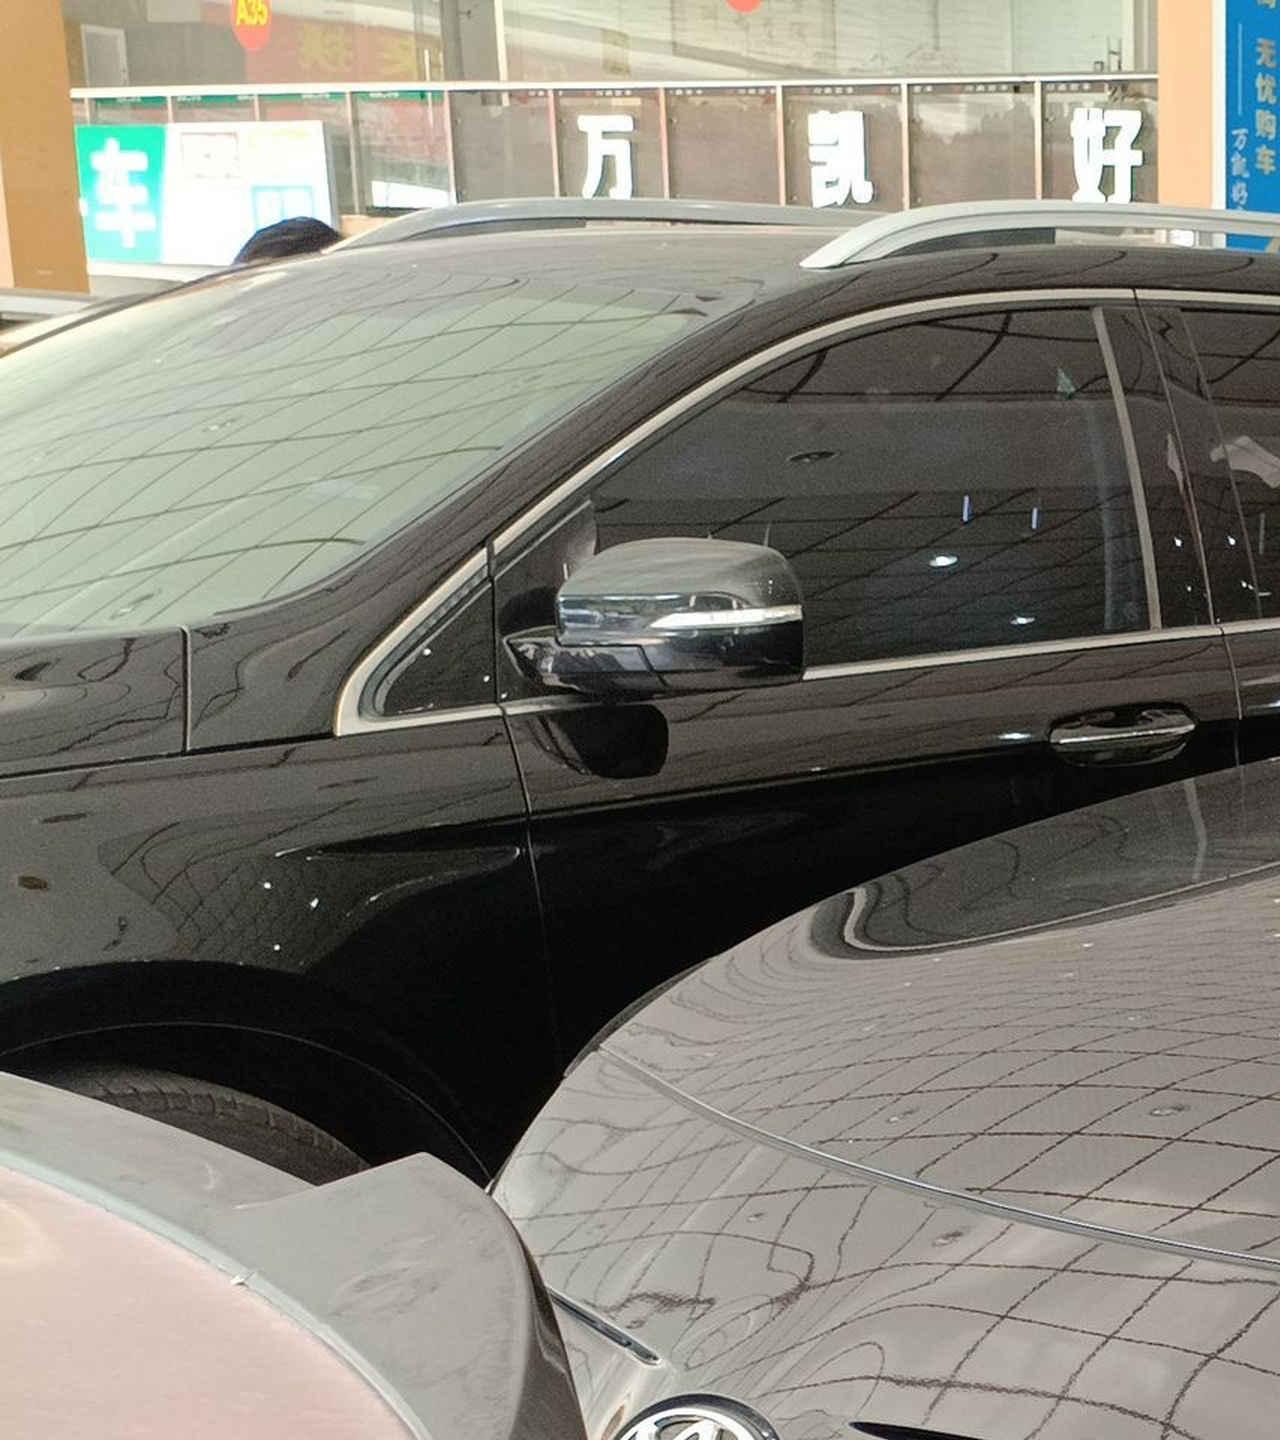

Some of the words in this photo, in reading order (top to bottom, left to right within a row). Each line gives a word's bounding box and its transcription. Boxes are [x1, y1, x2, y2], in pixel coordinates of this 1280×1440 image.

[1255, 37, 1278, 175] 无忧购车
[1071, 108, 1143, 204] 好
[1231, 128, 1249, 211] 万凯好
